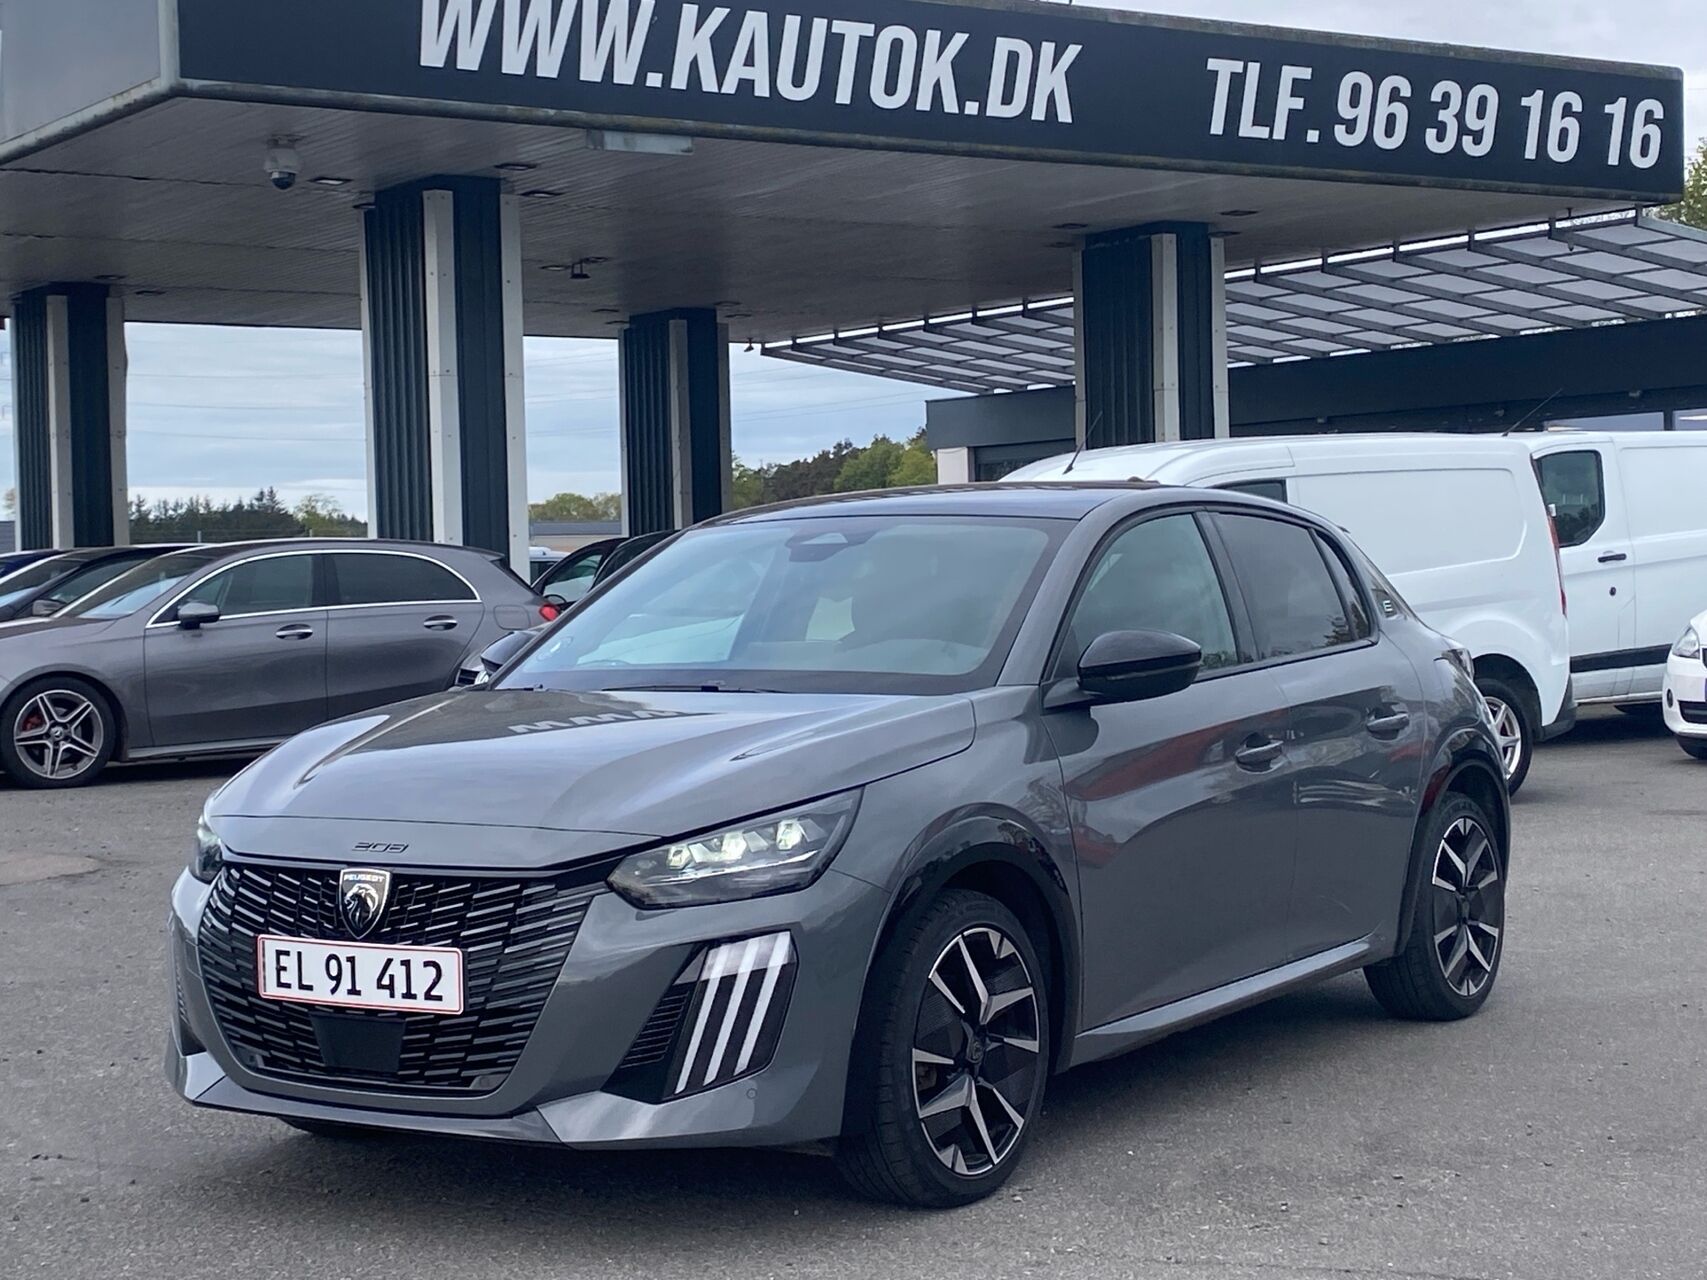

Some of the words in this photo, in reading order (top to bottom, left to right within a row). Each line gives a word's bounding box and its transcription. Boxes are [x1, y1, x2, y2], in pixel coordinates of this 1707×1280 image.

[420, 0, 1083, 124] WWW.KAUTOK.DK
[1206, 57, 1320, 143] TLF.
[1333, 71, 1412, 150] 96
[1424, 80, 1499, 157] 39
[1520, 89, 1583, 163] 16
[1603, 97, 1665, 169] 16
[343, 873, 386, 883] PEUGEOT
[275, 949, 314, 992] EL
[325, 953, 362, 997] 91
[376, 957, 443, 1002] 412
